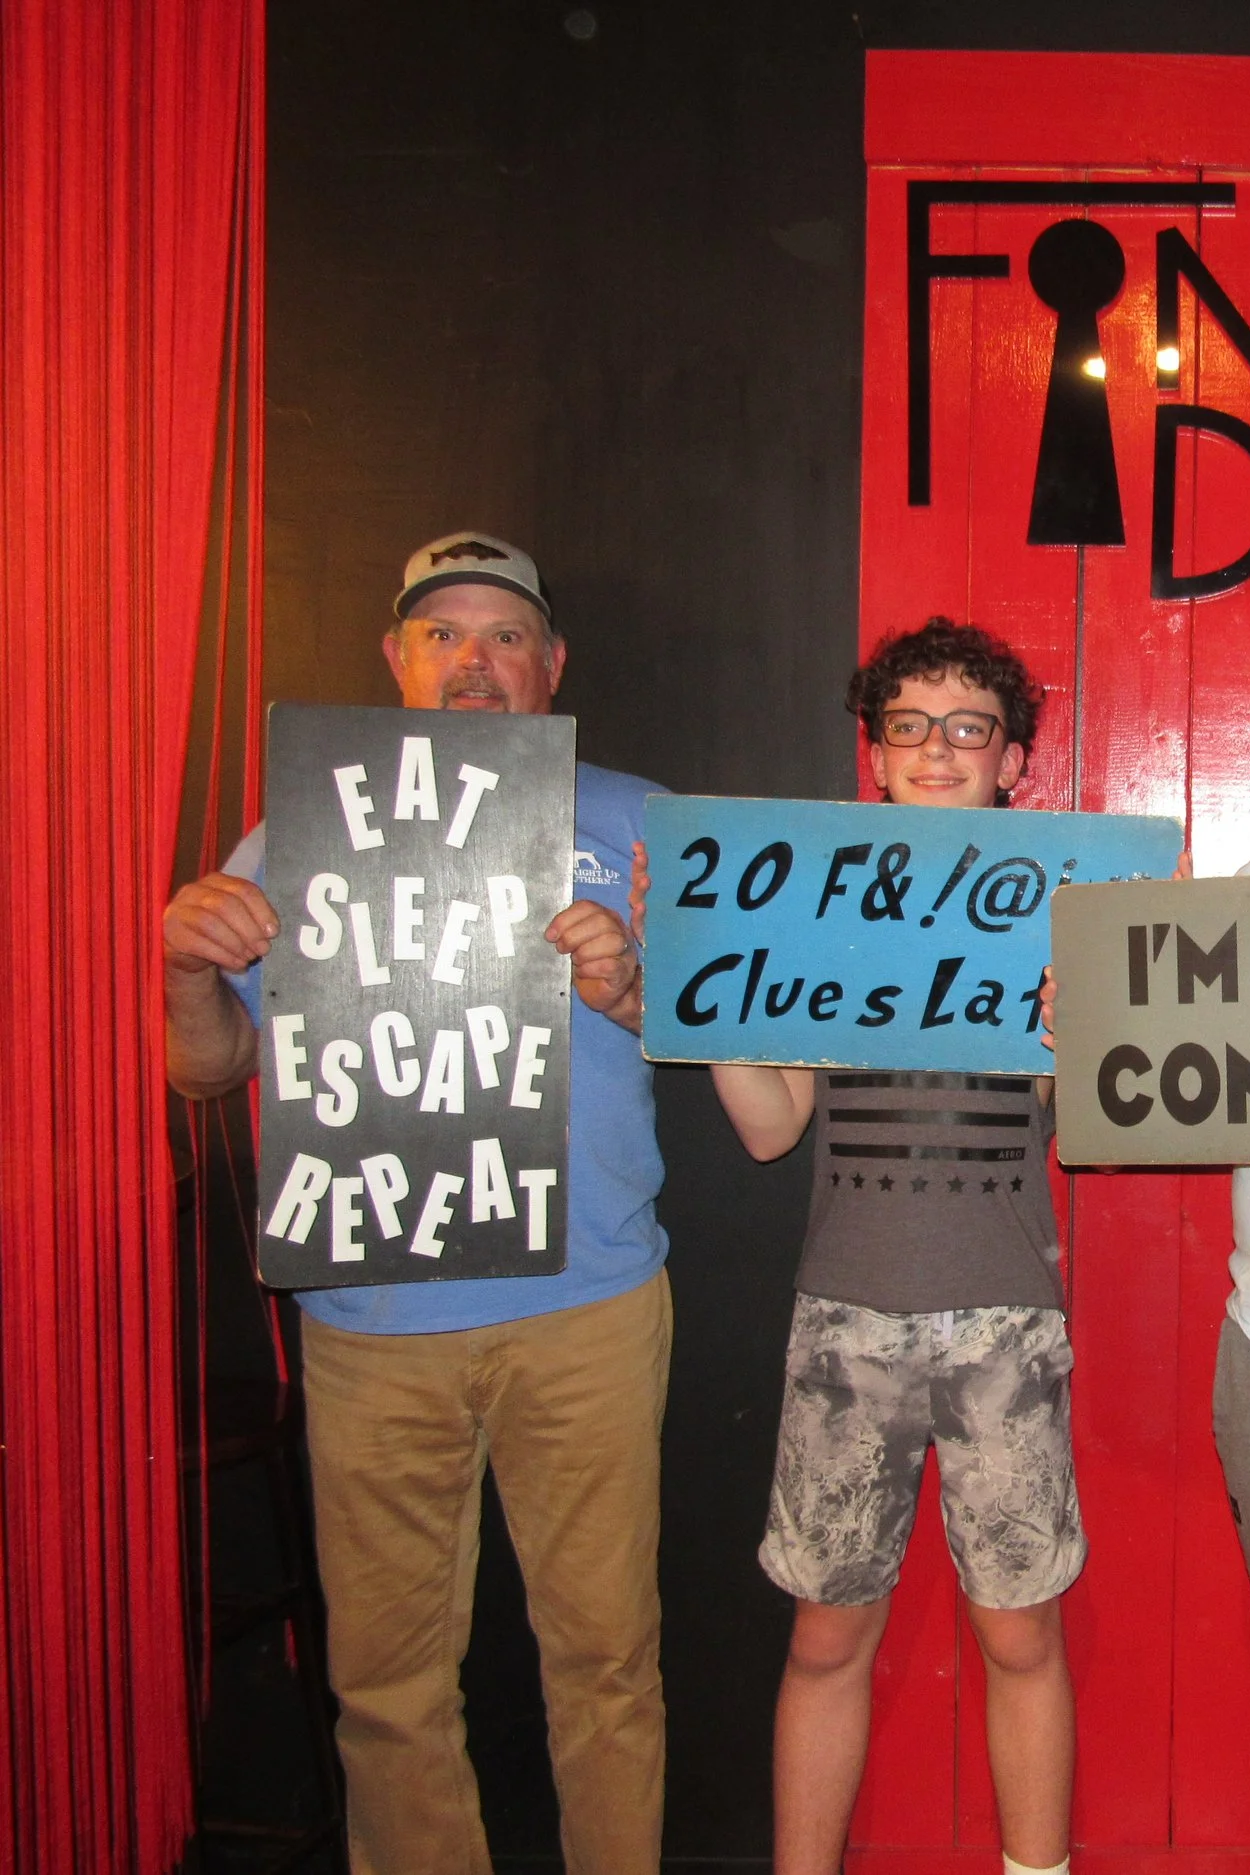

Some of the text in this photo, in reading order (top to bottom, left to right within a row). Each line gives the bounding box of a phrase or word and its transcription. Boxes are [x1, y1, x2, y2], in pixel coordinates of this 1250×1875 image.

[334, 737, 499, 851] EAT
[574, 869, 602, 878] AIGHT
[676, 836, 1151, 933] 20 F&!@
[301, 873, 527, 986] SLEEP
[1128, 921, 1239, 1006] I'M
[676, 948, 1046, 1033] Clues Lat
[273, 1005, 551, 1126] ESCAPE
[266, 1139, 556, 1262] REPEAT
